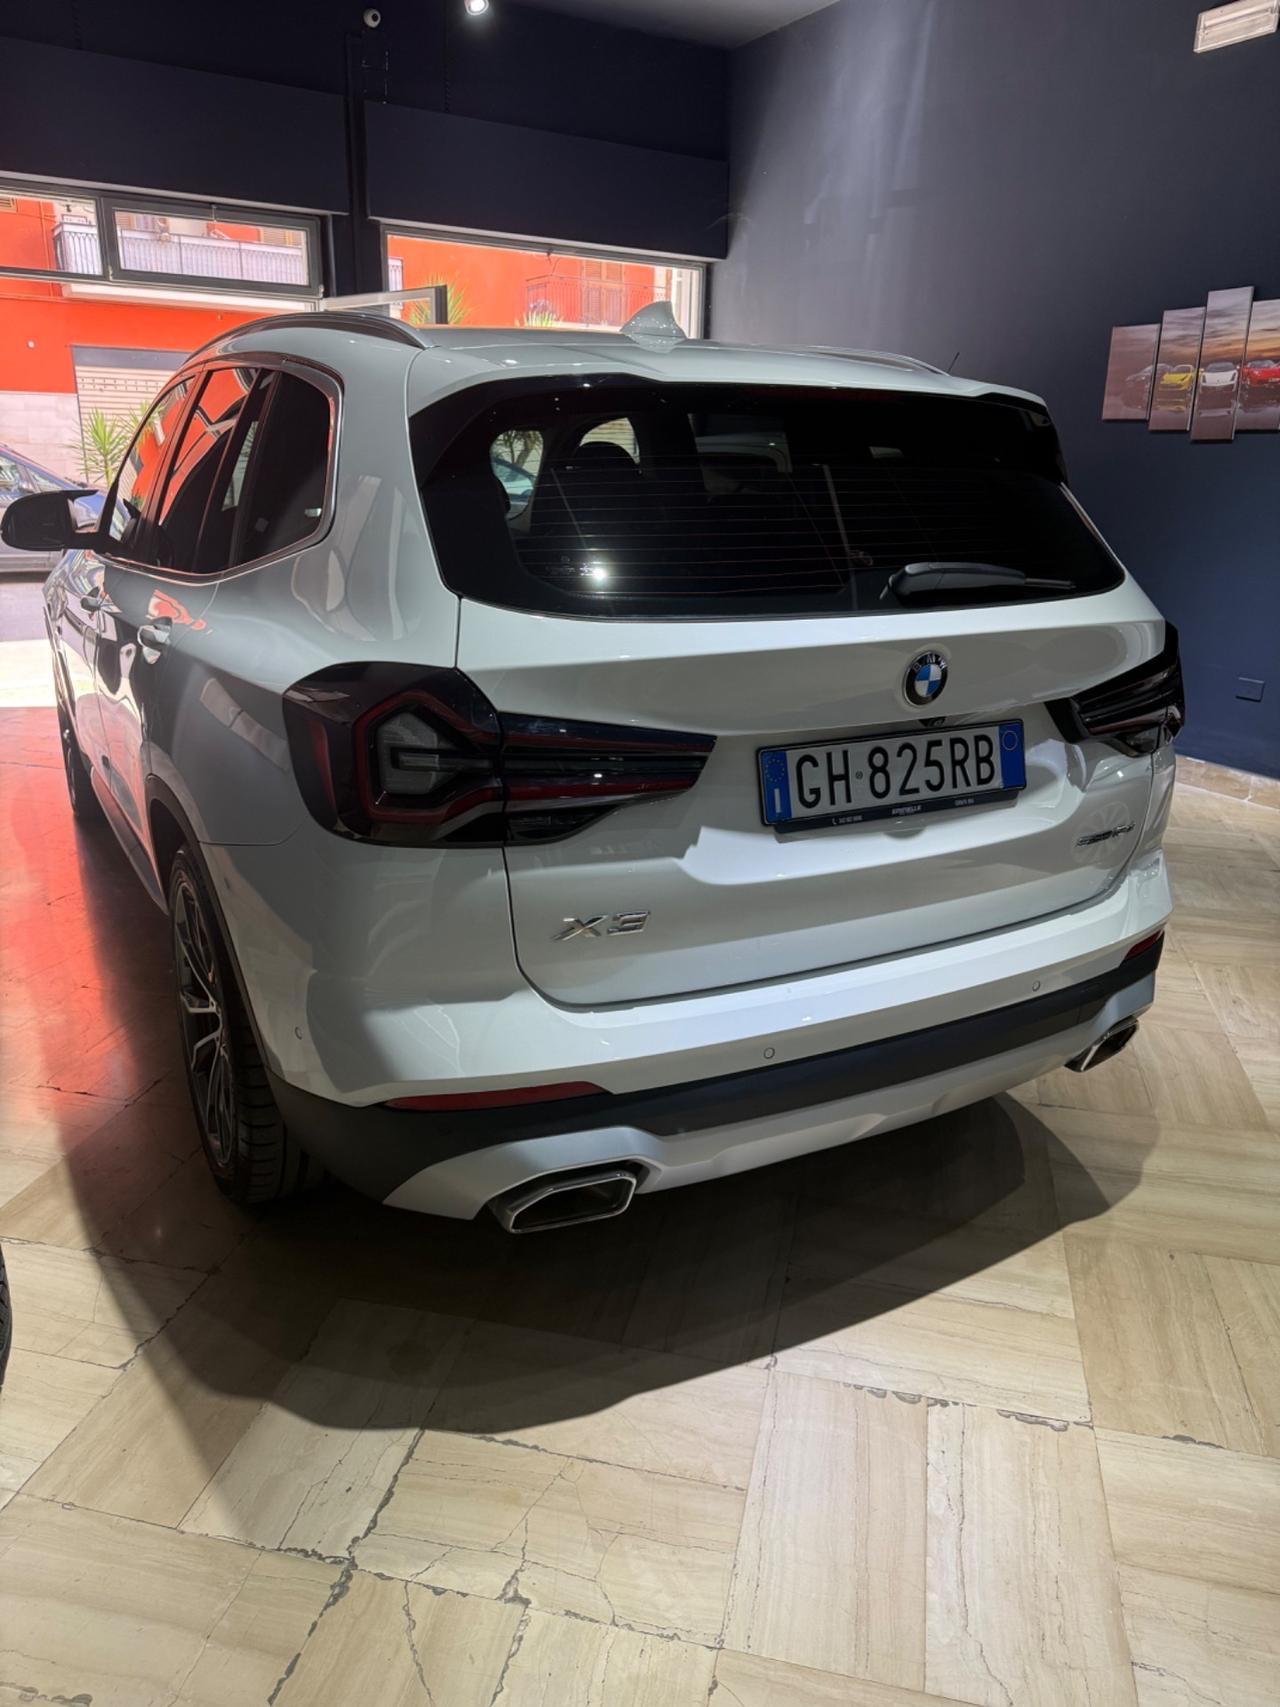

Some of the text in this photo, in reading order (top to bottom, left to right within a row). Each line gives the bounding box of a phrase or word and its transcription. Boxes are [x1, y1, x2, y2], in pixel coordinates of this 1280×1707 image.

[912, 653, 948, 671] BMW
[796, 733, 996, 809] GH 825RB
[774, 788, 781, 813] I
[550, 911, 650, 941] X3
